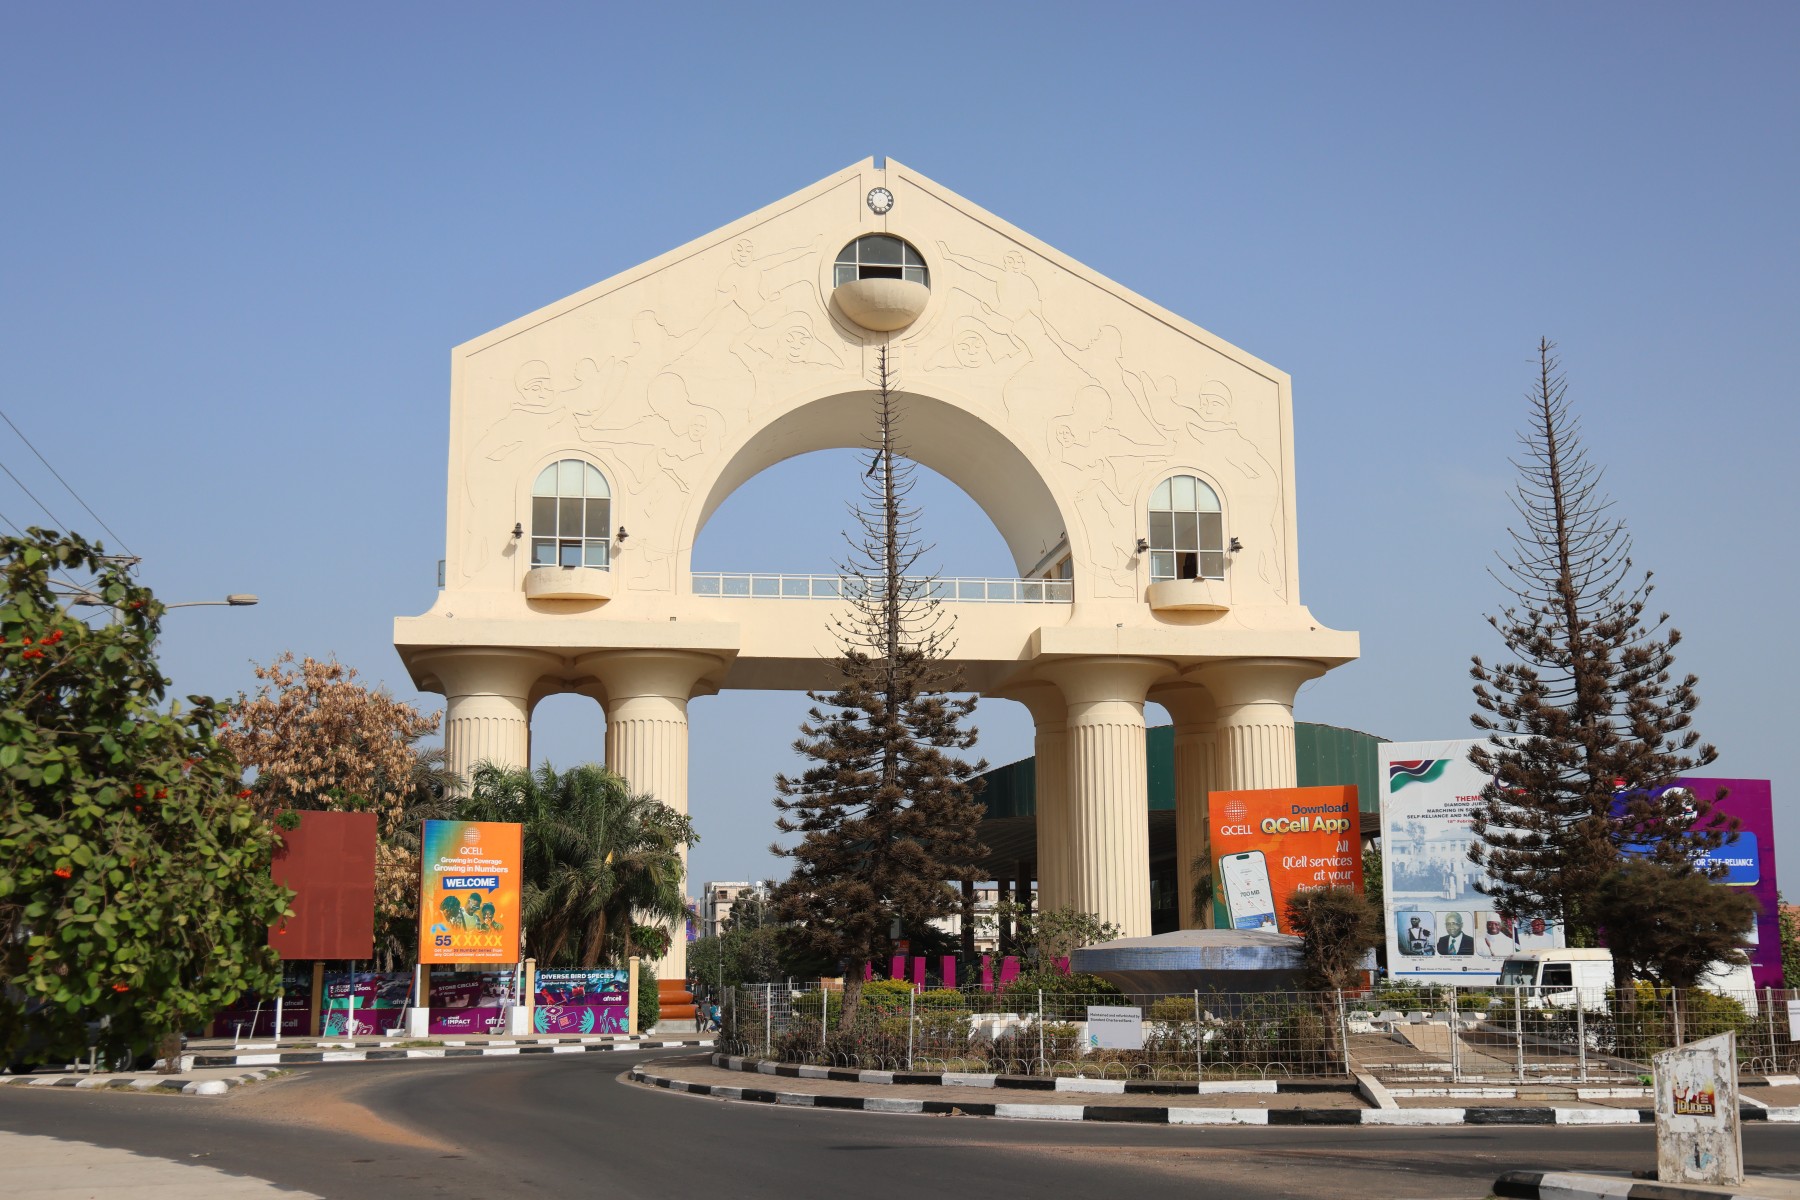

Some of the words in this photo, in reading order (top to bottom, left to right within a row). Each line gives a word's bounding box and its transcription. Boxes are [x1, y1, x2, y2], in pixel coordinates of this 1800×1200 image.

[1291, 802, 1349, 814] Download
[1220, 824, 1253, 836] QCELL
[1260, 816, 1310, 834] QCell
[1312, 816, 1350, 835] App
[460, 847, 483, 855] QCELL
[1336, 840, 1348, 852] All
[434, 864, 465, 872] Growing
[1282, 856, 1307, 870] QCell
[1309, 856, 1352, 867] services
[446, 878, 496, 887] WELCOME
[1314, 870, 1326, 881] at
[1328, 870, 1354, 883] your
[1677, 1099, 1713, 1113] LOUDER
